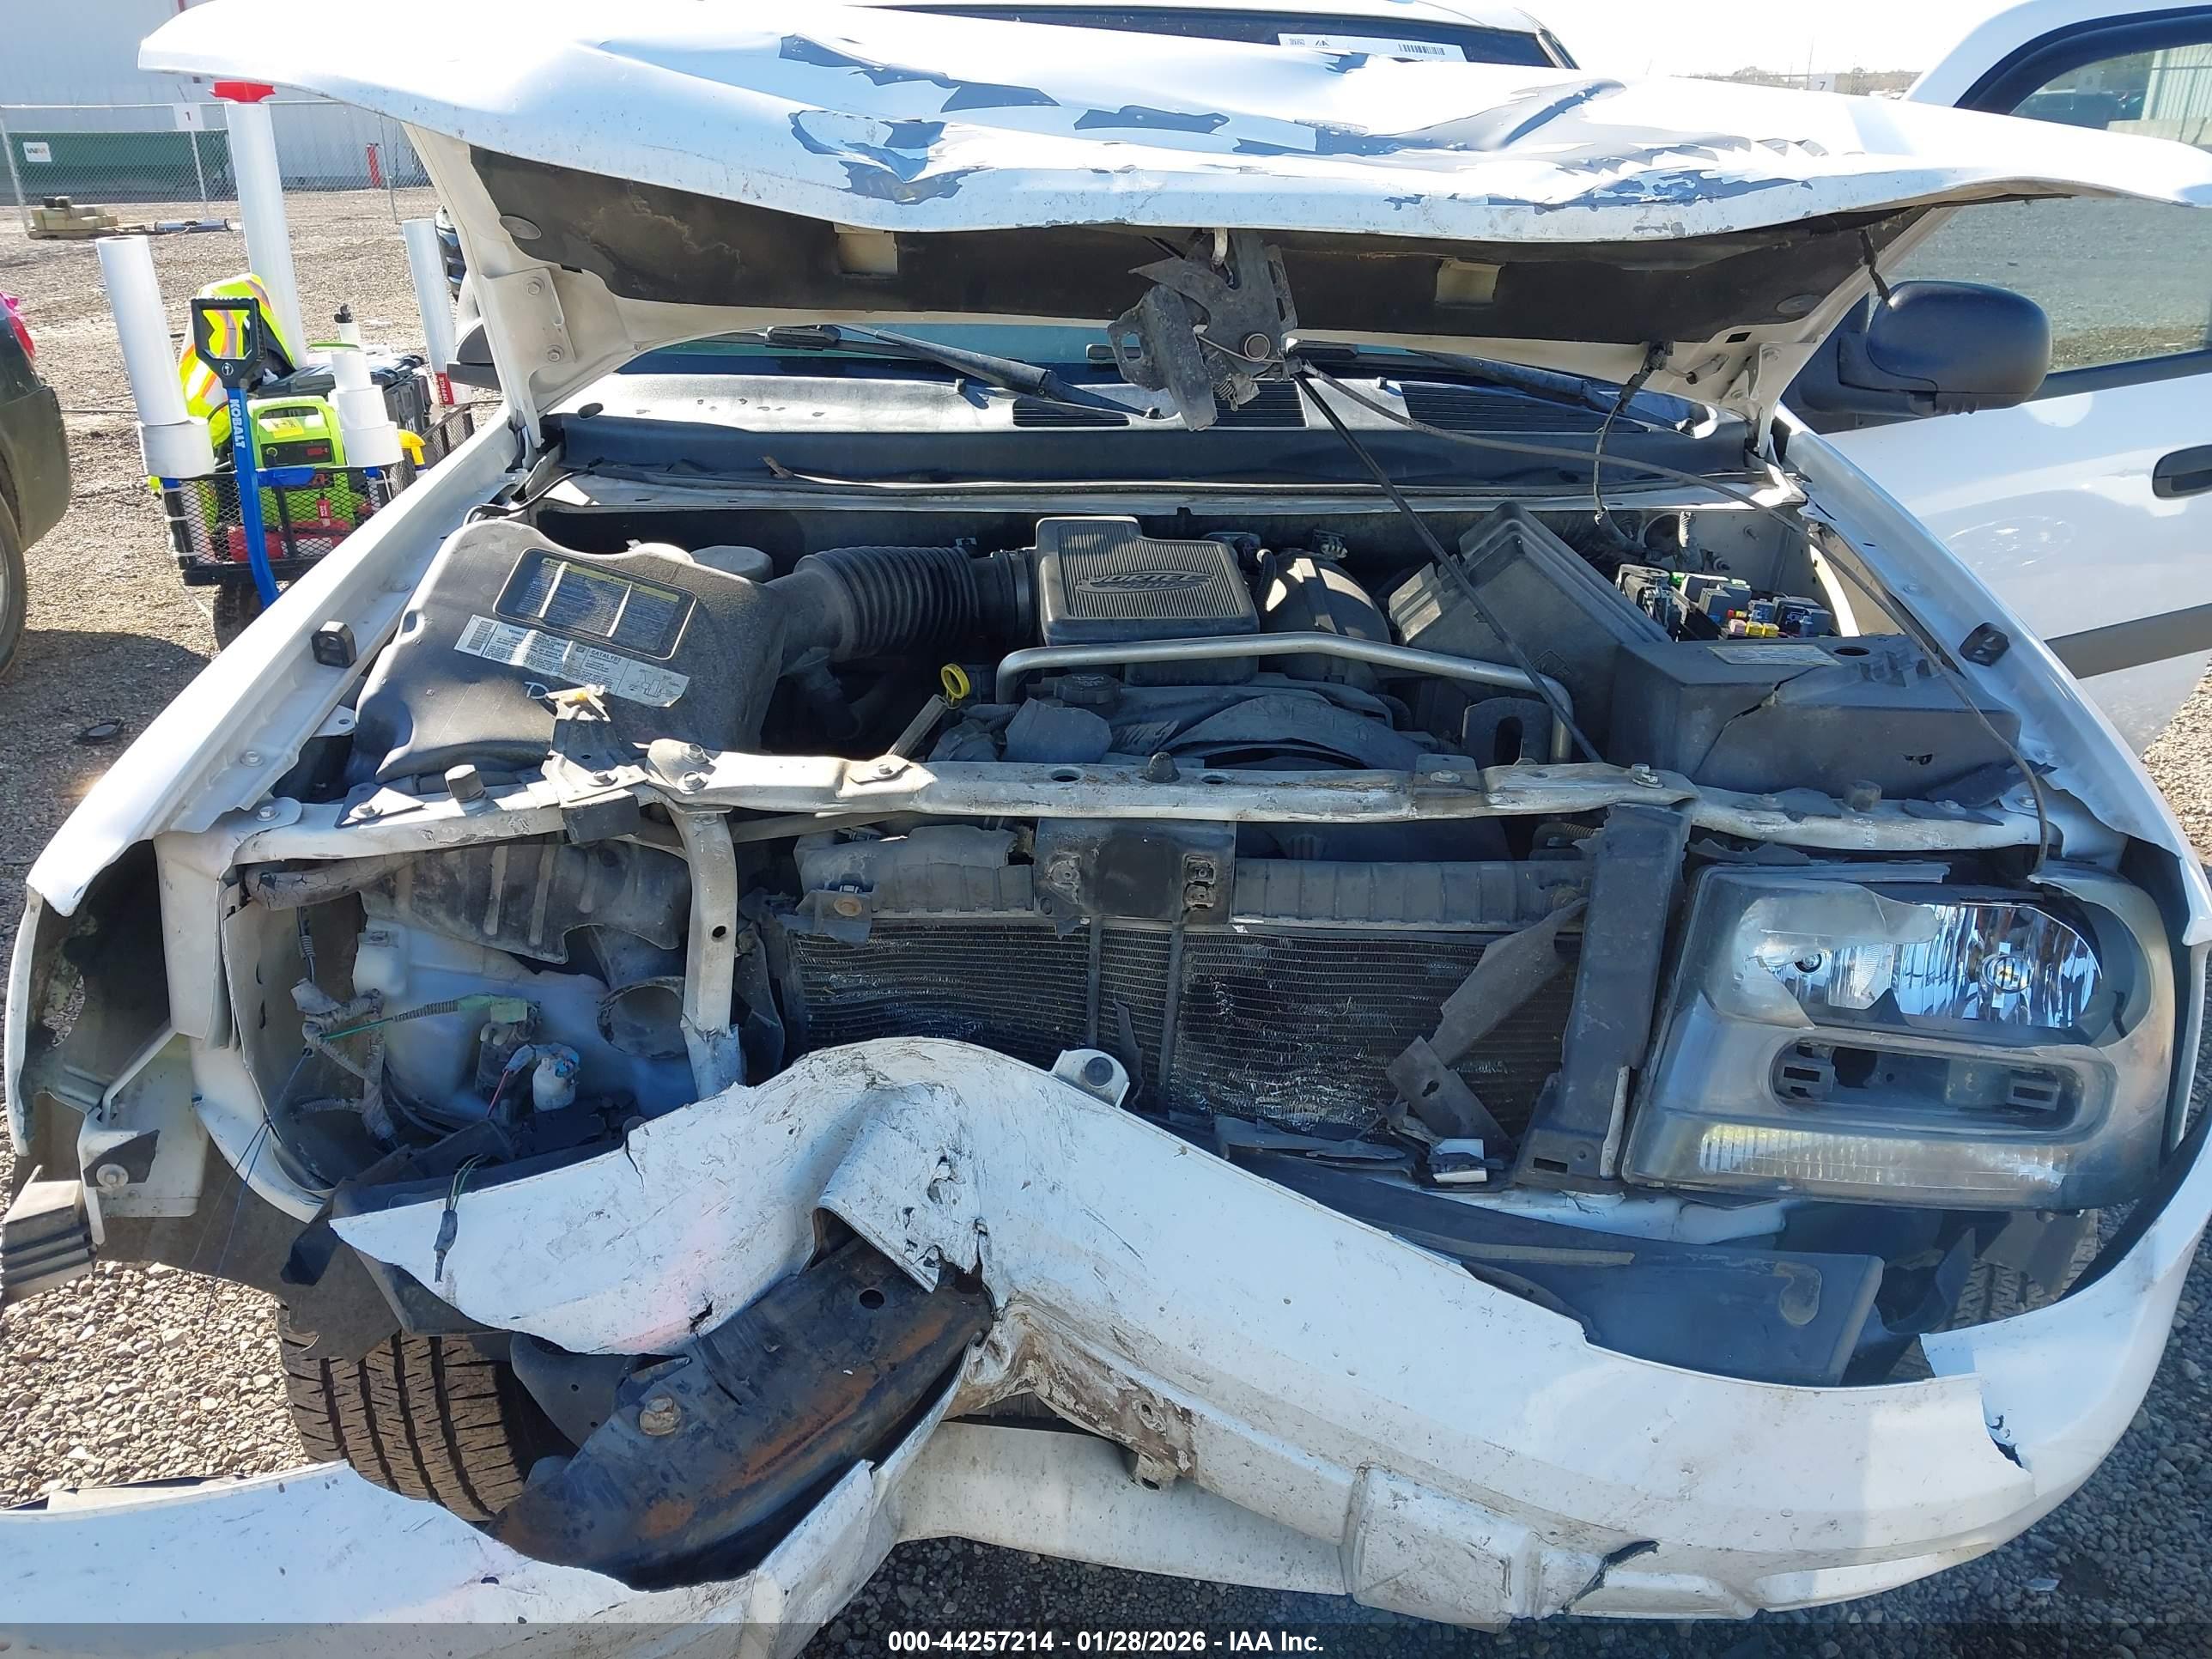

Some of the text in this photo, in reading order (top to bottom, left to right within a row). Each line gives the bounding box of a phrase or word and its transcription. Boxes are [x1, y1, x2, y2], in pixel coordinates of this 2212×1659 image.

[1819, 81, 1826, 91] 7
[185, 112, 191, 121] 1
[438, 376, 449, 402] OFFICE
[229, 398, 246, 449] KOBALT
[590, 650, 623, 663] CATALYST
